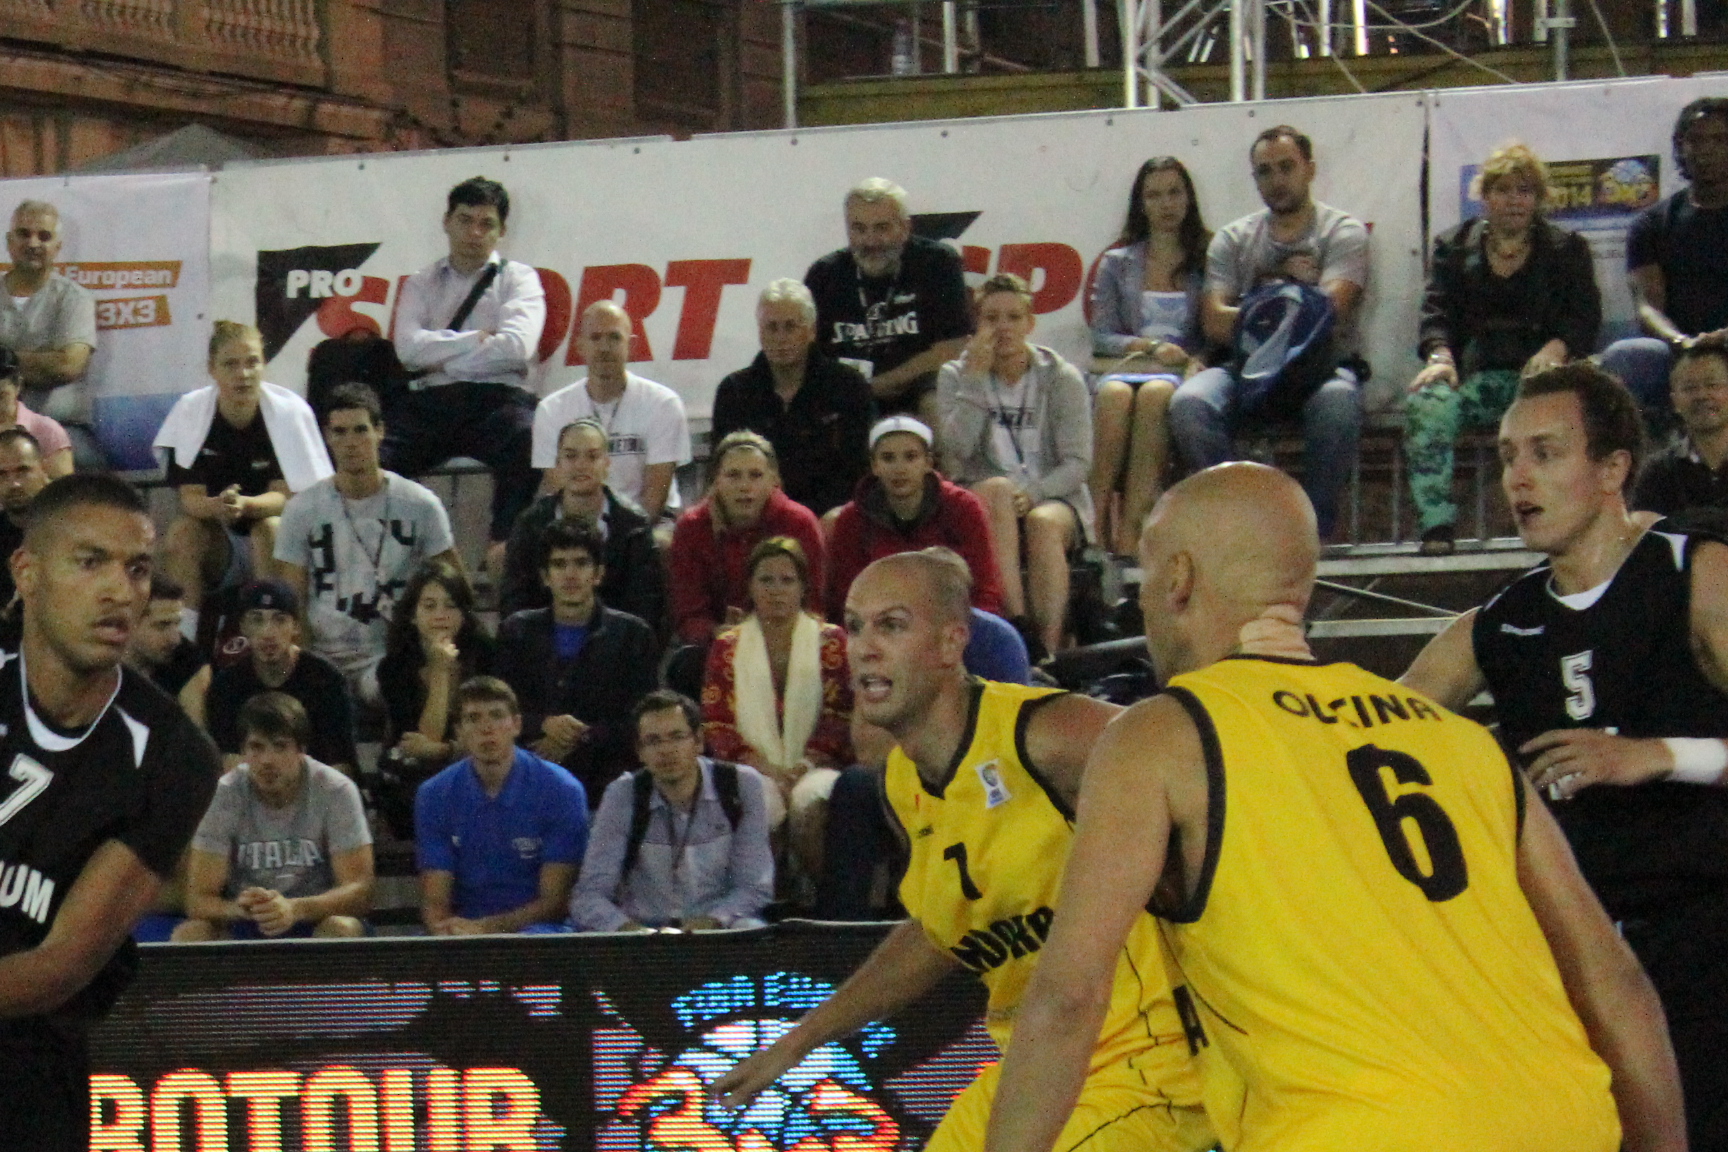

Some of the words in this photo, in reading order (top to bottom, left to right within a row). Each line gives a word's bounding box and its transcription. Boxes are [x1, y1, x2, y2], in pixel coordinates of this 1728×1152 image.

[70, 266, 174, 288] European
[286, 268, 366, 299] PRO
[98, 299, 157, 327] 3X3
[316, 258, 753, 367] SRT
[1560, 650, 1597, 721] 5
[1345, 743, 1470, 903] 6
